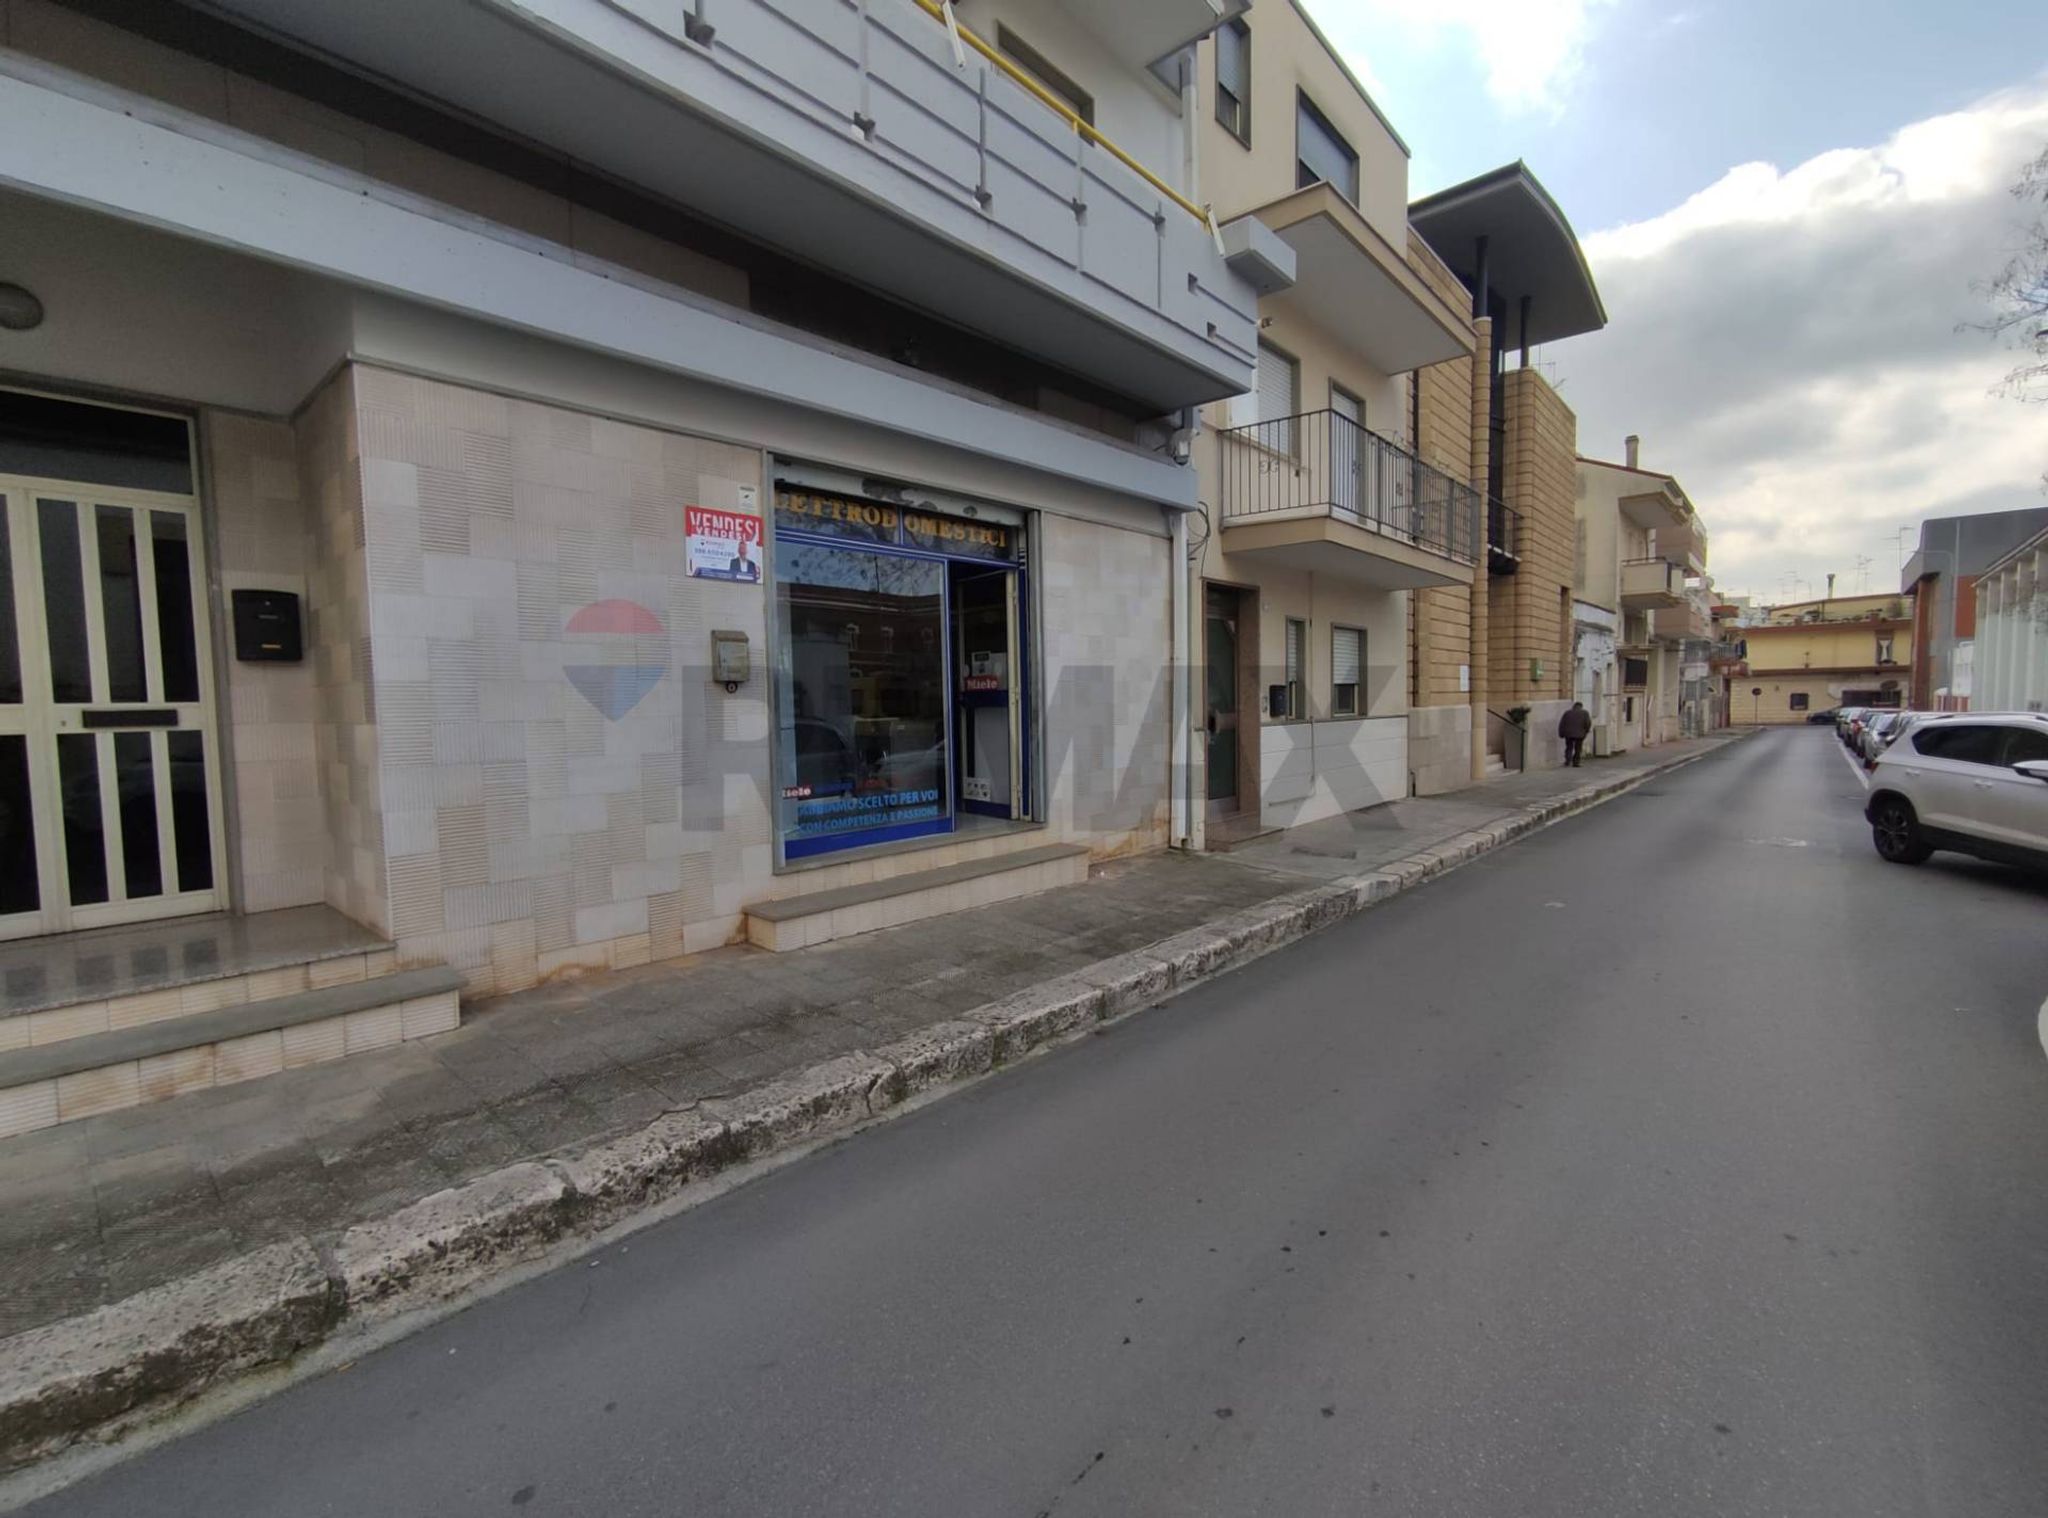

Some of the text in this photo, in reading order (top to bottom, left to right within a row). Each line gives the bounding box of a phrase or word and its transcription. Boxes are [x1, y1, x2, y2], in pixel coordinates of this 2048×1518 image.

[690, 511, 760, 542] VENDESI
[967, 678, 998, 690] Miele
[782, 788, 811, 798] iele
[858, 794, 898, 809] SCELTO
[900, 791, 919, 804] PER
[920, 788, 938, 801] VOI
